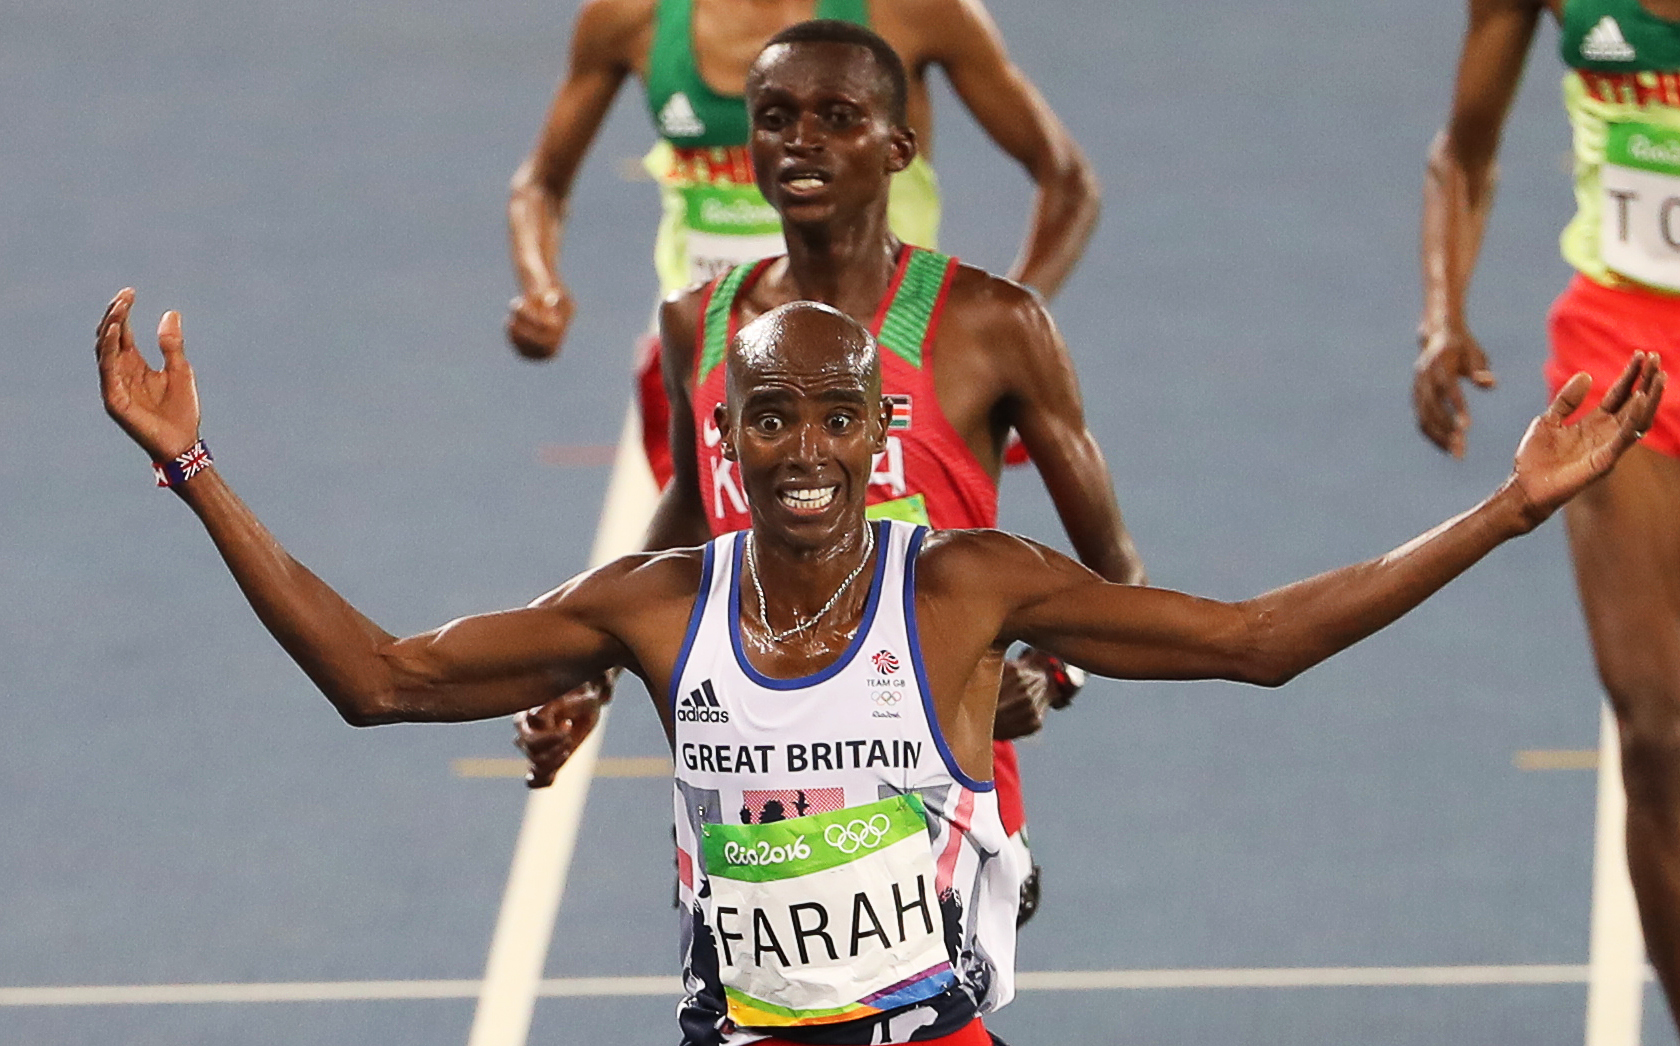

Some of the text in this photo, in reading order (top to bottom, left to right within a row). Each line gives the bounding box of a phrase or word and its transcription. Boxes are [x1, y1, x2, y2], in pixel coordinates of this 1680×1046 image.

[866, 679, 906, 687] TEAM GB
[677, 707, 729, 723] adidas
[682, 739, 922, 773] GREAT BRITAIN
[723, 835, 811, 866] Rio2016
[716, 874, 934, 967] FARAH
